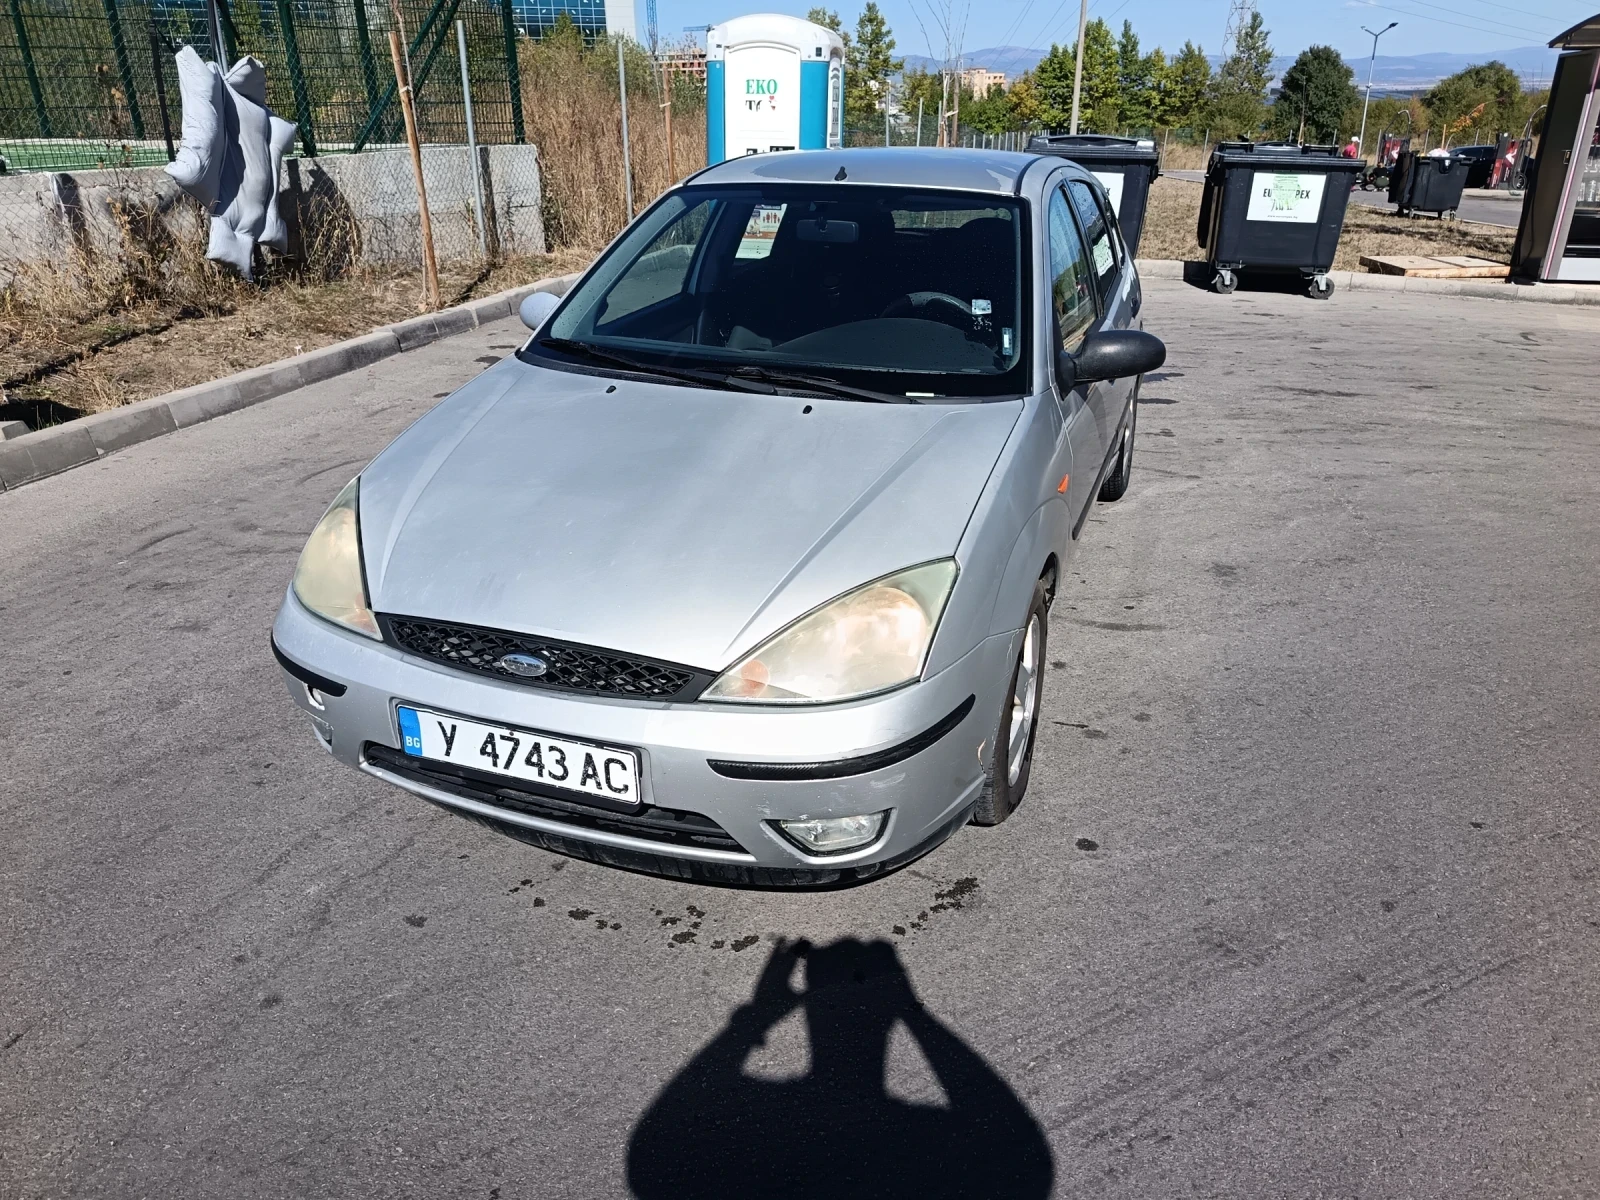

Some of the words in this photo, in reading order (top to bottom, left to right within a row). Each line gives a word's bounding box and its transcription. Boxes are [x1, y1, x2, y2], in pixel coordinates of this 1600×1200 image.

[745, 78, 778, 95] EKO
[405, 735, 421, 748] BG
[437, 720, 457, 757] Y
[479, 732, 569, 781] 4743
[580, 752, 629, 794] AC
